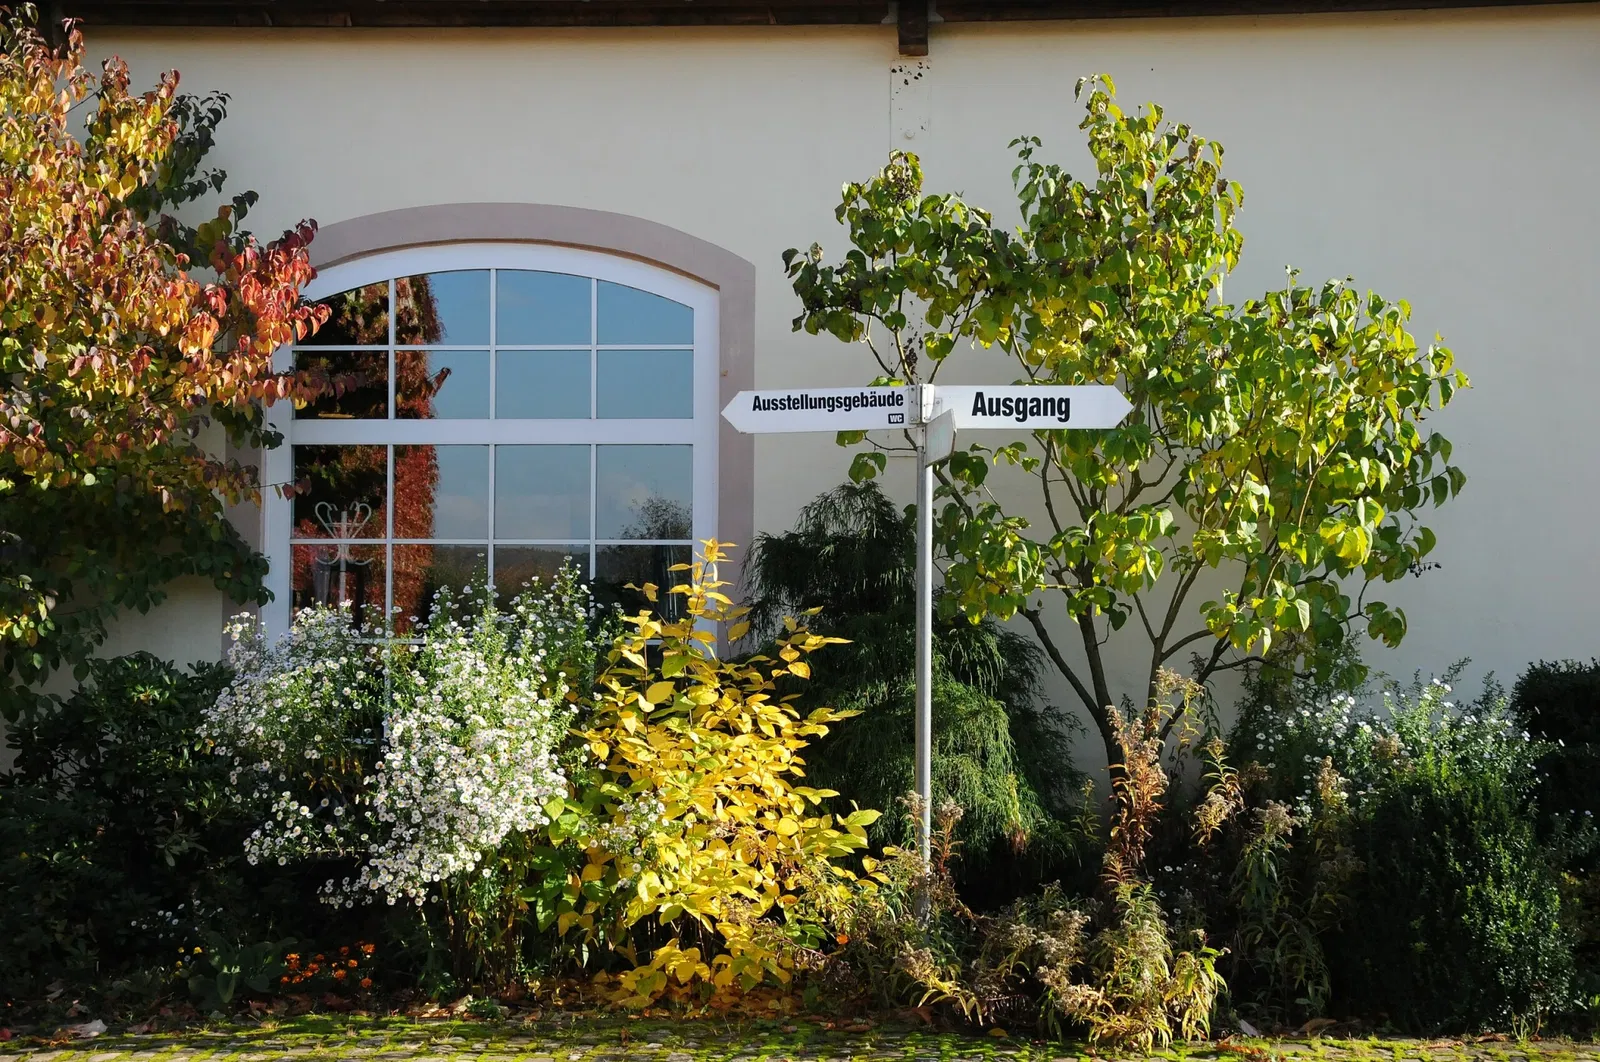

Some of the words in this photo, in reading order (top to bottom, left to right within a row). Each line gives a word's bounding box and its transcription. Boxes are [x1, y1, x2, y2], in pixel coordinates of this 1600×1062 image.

[752, 391, 904, 412] Ausstellungsgebäude
[972, 391, 1070, 422] Ausgang
[889, 414, 903, 423] WC
